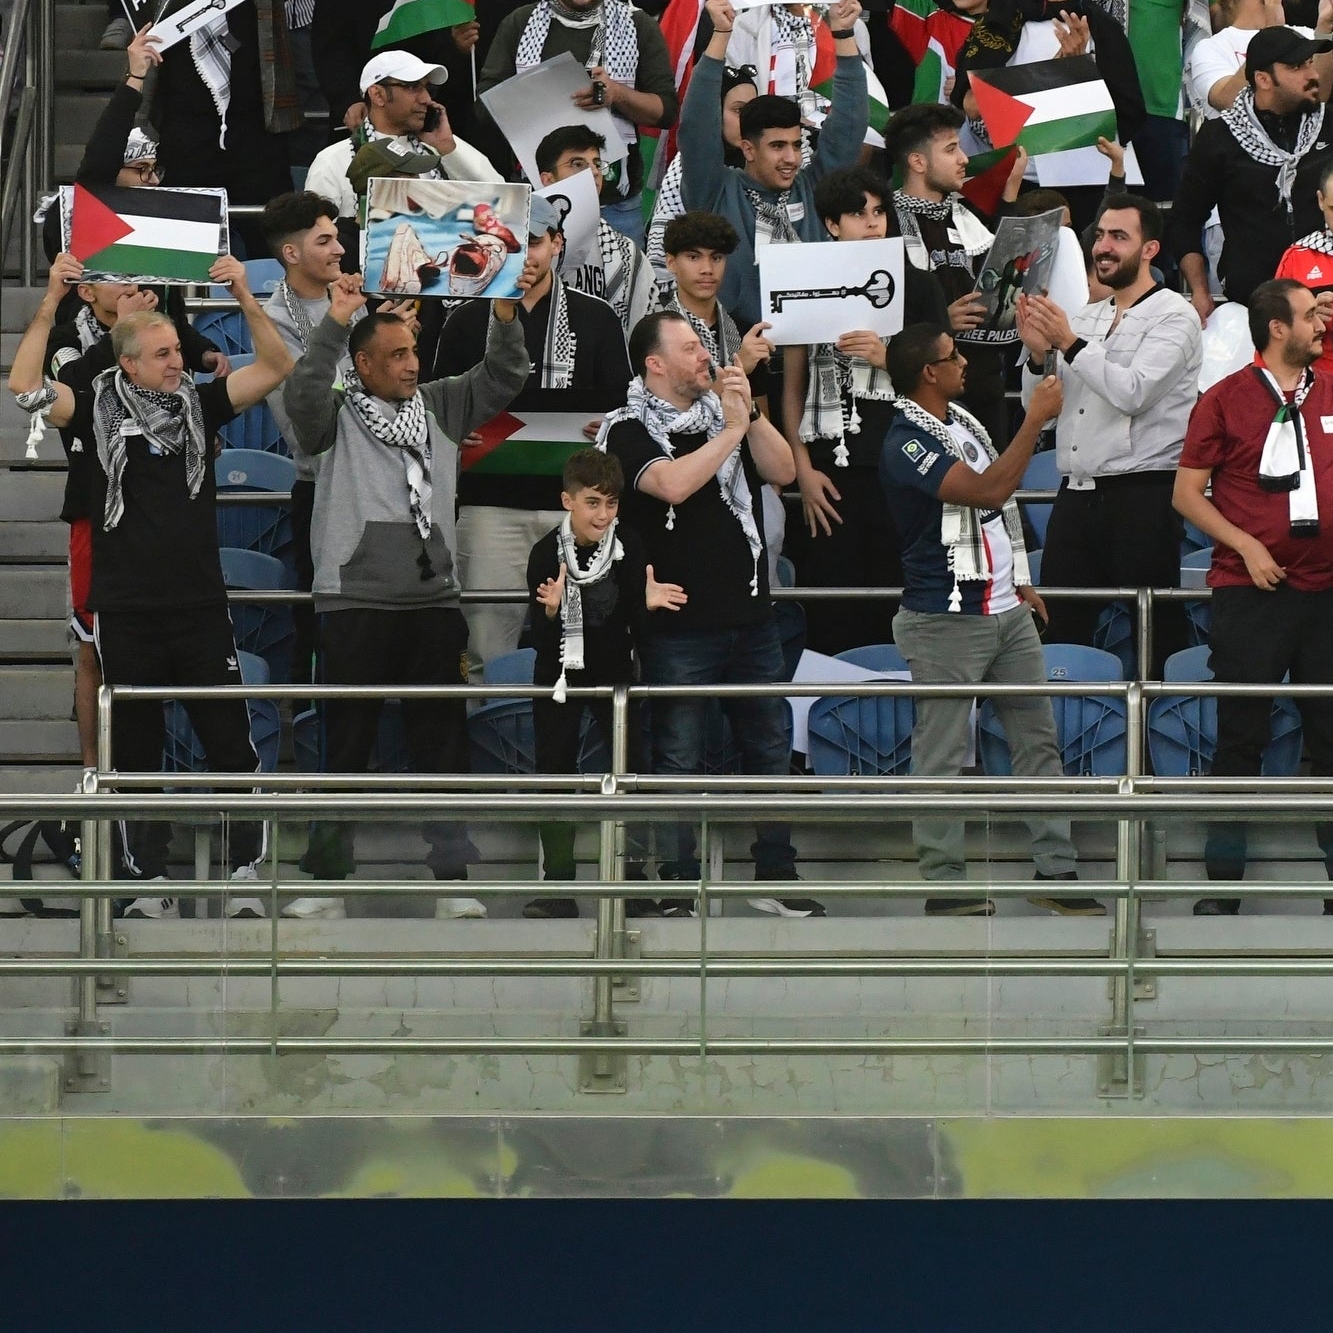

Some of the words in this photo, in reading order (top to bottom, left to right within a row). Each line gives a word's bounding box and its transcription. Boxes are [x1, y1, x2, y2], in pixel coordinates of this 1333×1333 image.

[956, 328, 986, 341] FREE
[986, 328, 1021, 342] PALESTI
[1053, 668, 1066, 677] 25
